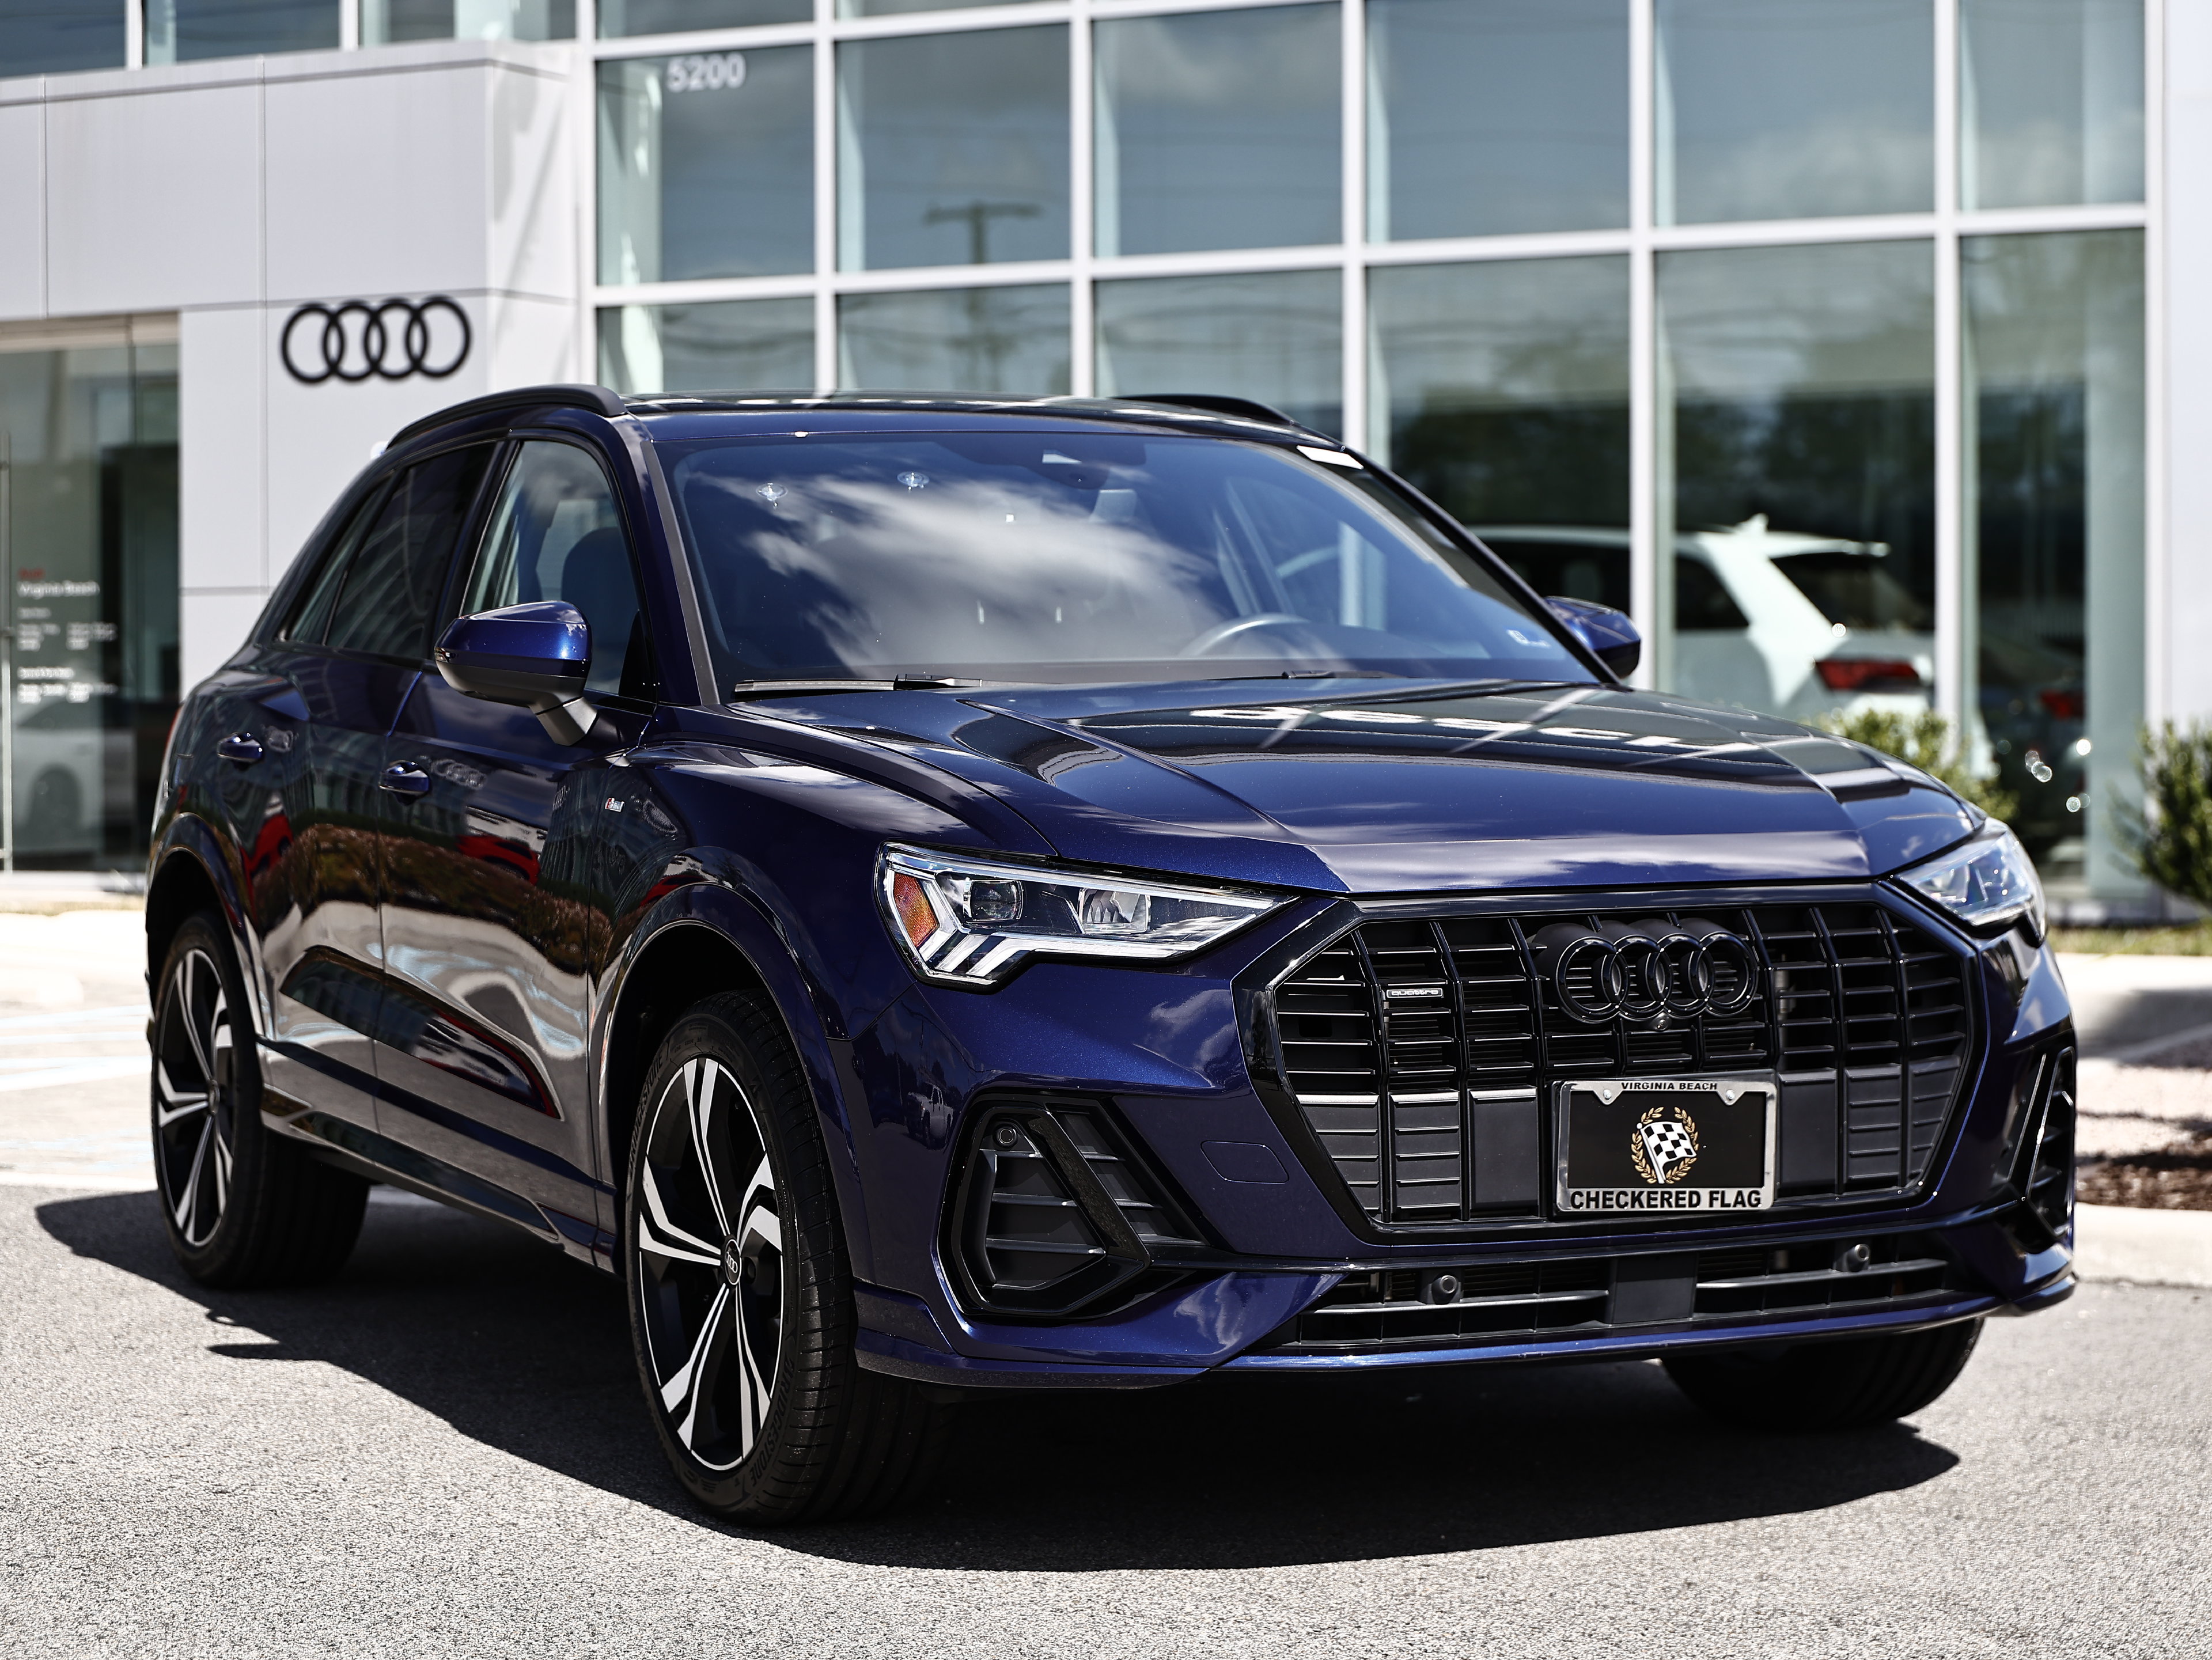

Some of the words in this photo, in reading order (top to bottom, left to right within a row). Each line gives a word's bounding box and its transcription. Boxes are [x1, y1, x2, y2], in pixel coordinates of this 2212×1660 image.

[667, 52, 747, 93] 5200
[1621, 1082, 1675, 1090] VIRGINIA
[1679, 1082, 1718, 1090] BEACH
[1570, 1190, 1700, 1209] CHECKERED
[1709, 1189, 1762, 1208] FLAG
